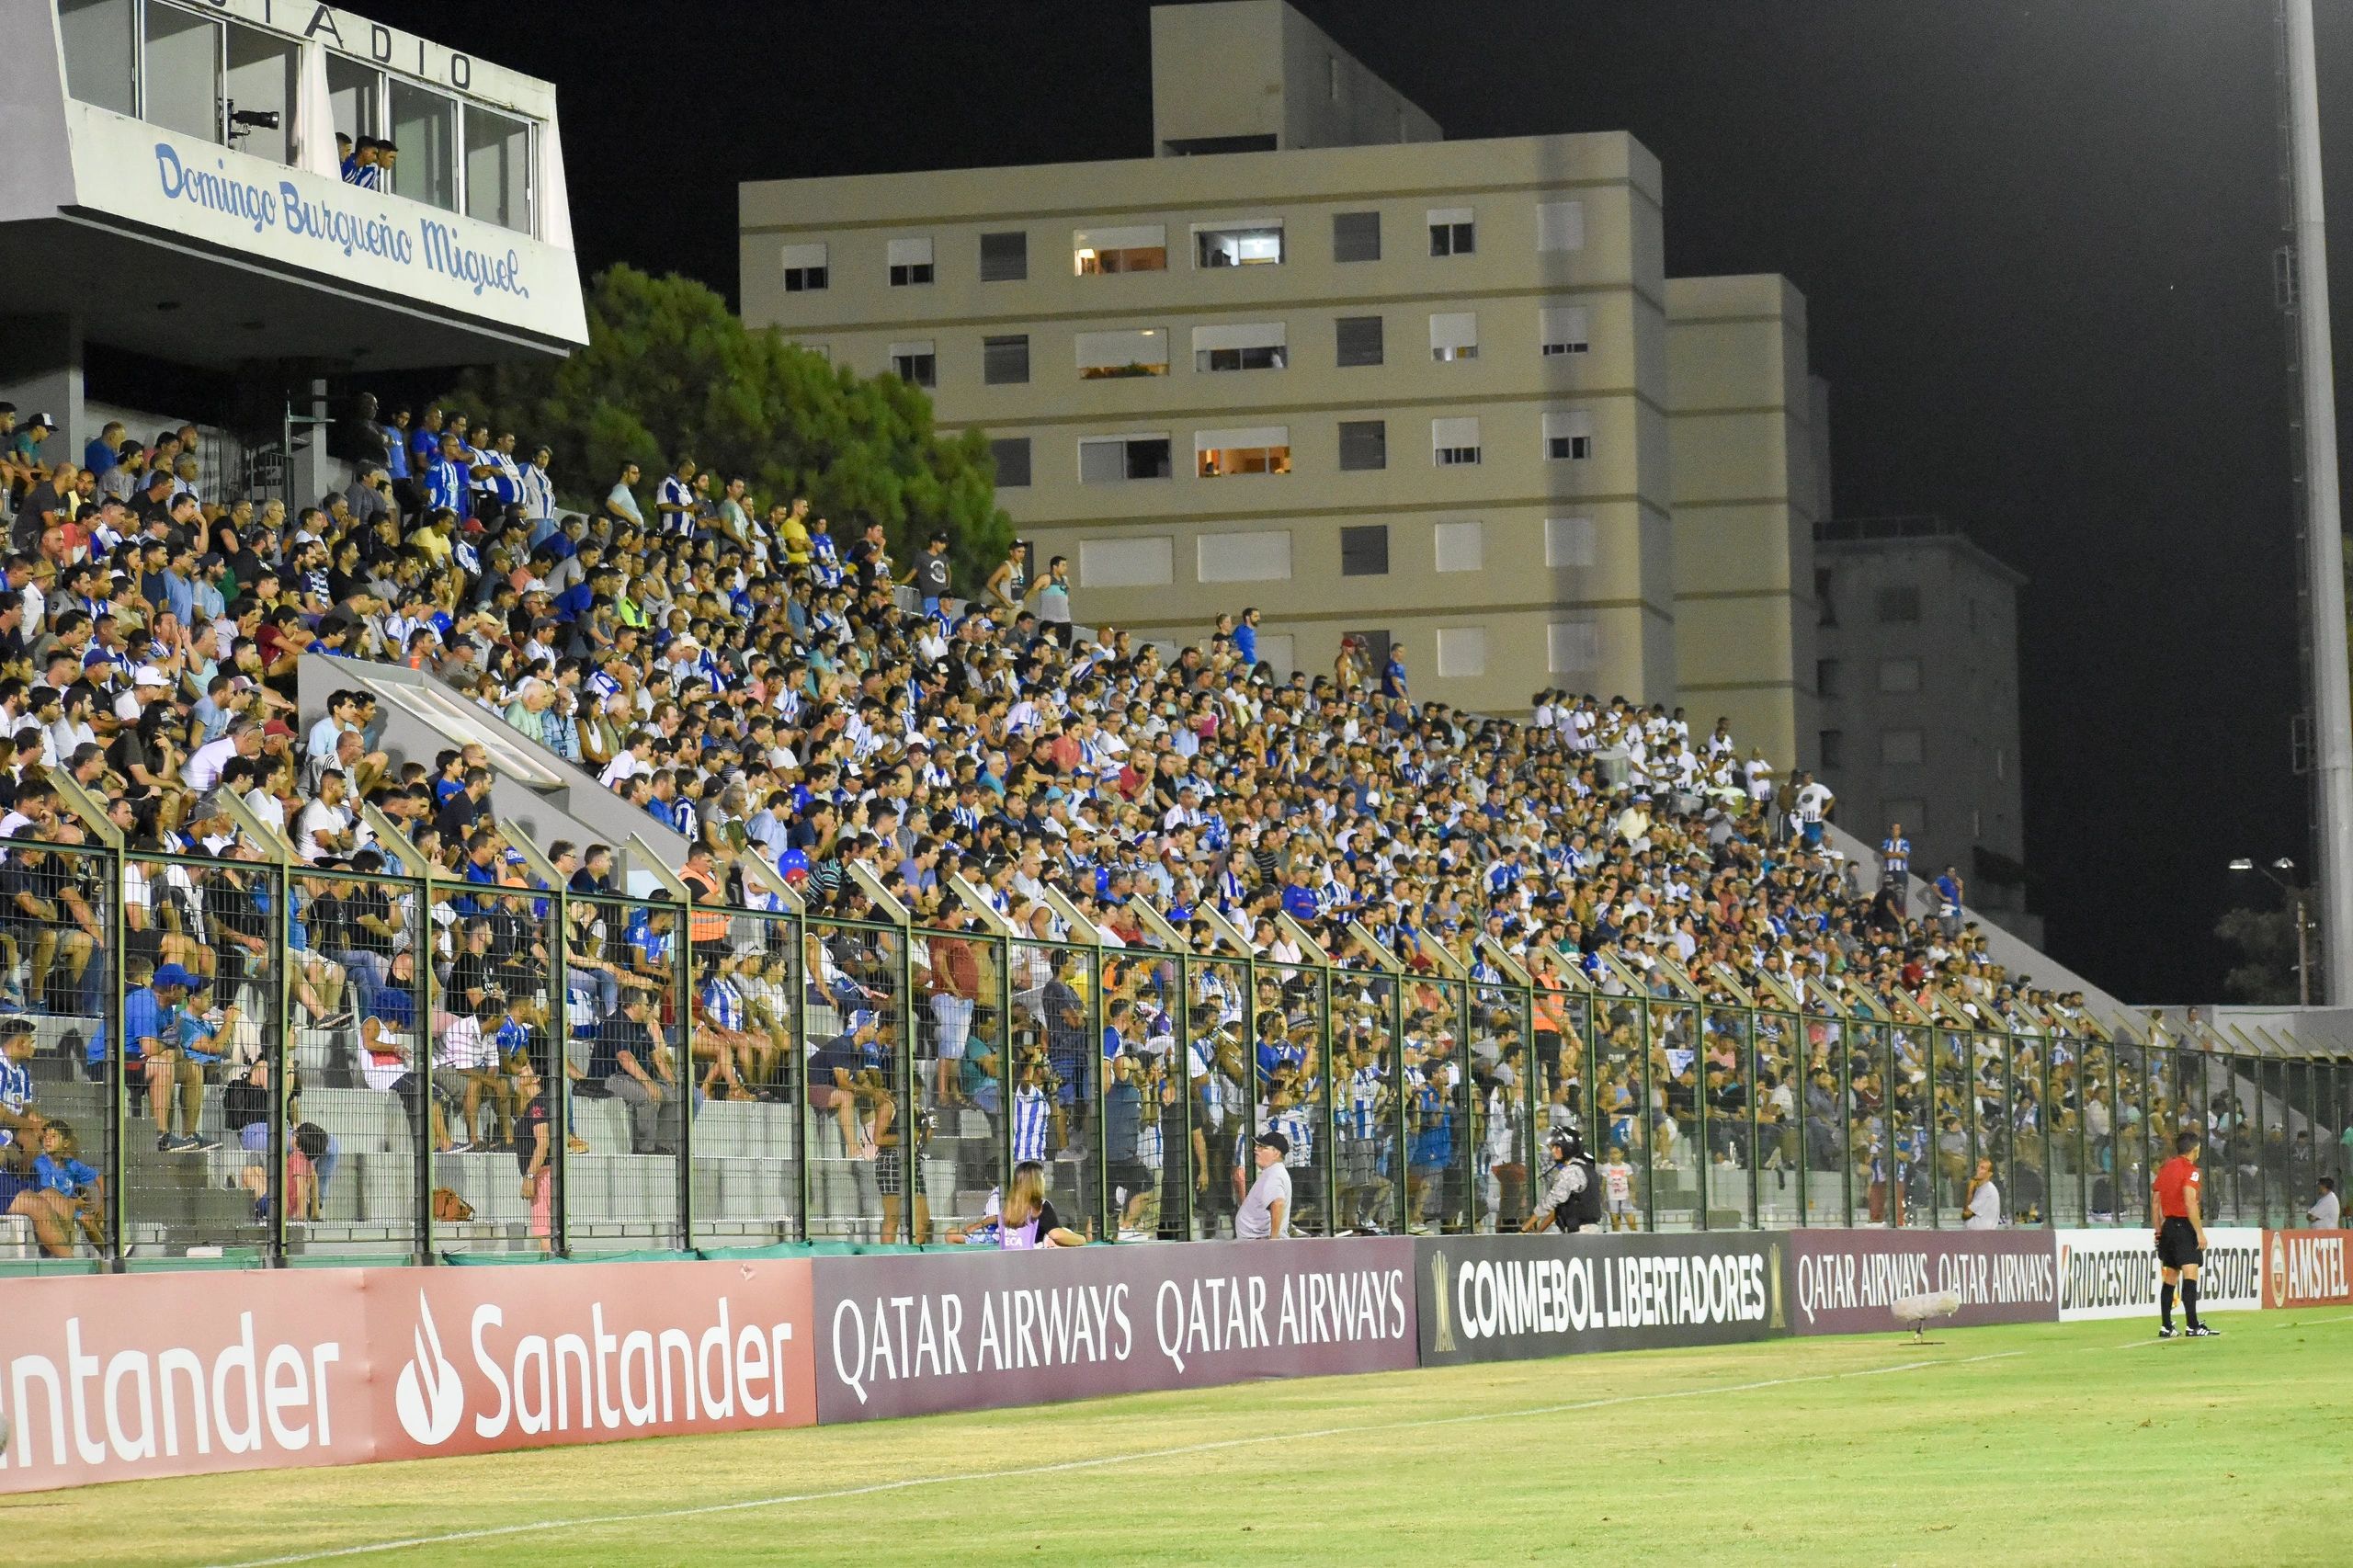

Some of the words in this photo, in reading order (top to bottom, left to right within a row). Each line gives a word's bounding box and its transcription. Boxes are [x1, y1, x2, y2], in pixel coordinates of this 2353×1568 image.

[155, 142, 276, 233] Domingo
[279, 181, 413, 265] Burgueño
[1458, 1257, 1603, 1339] CONMEBOL
[1604, 1253, 1766, 1328] LIBERTADORES
[1798, 1254, 1858, 1324] QATAR
[1860, 1253, 1930, 1307] AIRWAYS
[1991, 1253, 2053, 1303] AIRWAYS
[2061, 1244, 2157, 1310] BRIDGESTONE
[2288, 1237, 2348, 1299] AMSTEL
[471, 1297, 792, 1438] Santander
[832, 1293, 970, 1404] QATAR
[977, 1283, 1132, 1371] AIRWAYS
[1155, 1276, 1268, 1374] QATAR
[1279, 1269, 1405, 1346] AIRWAYS
[0, 1311, 339, 1469] ntander
